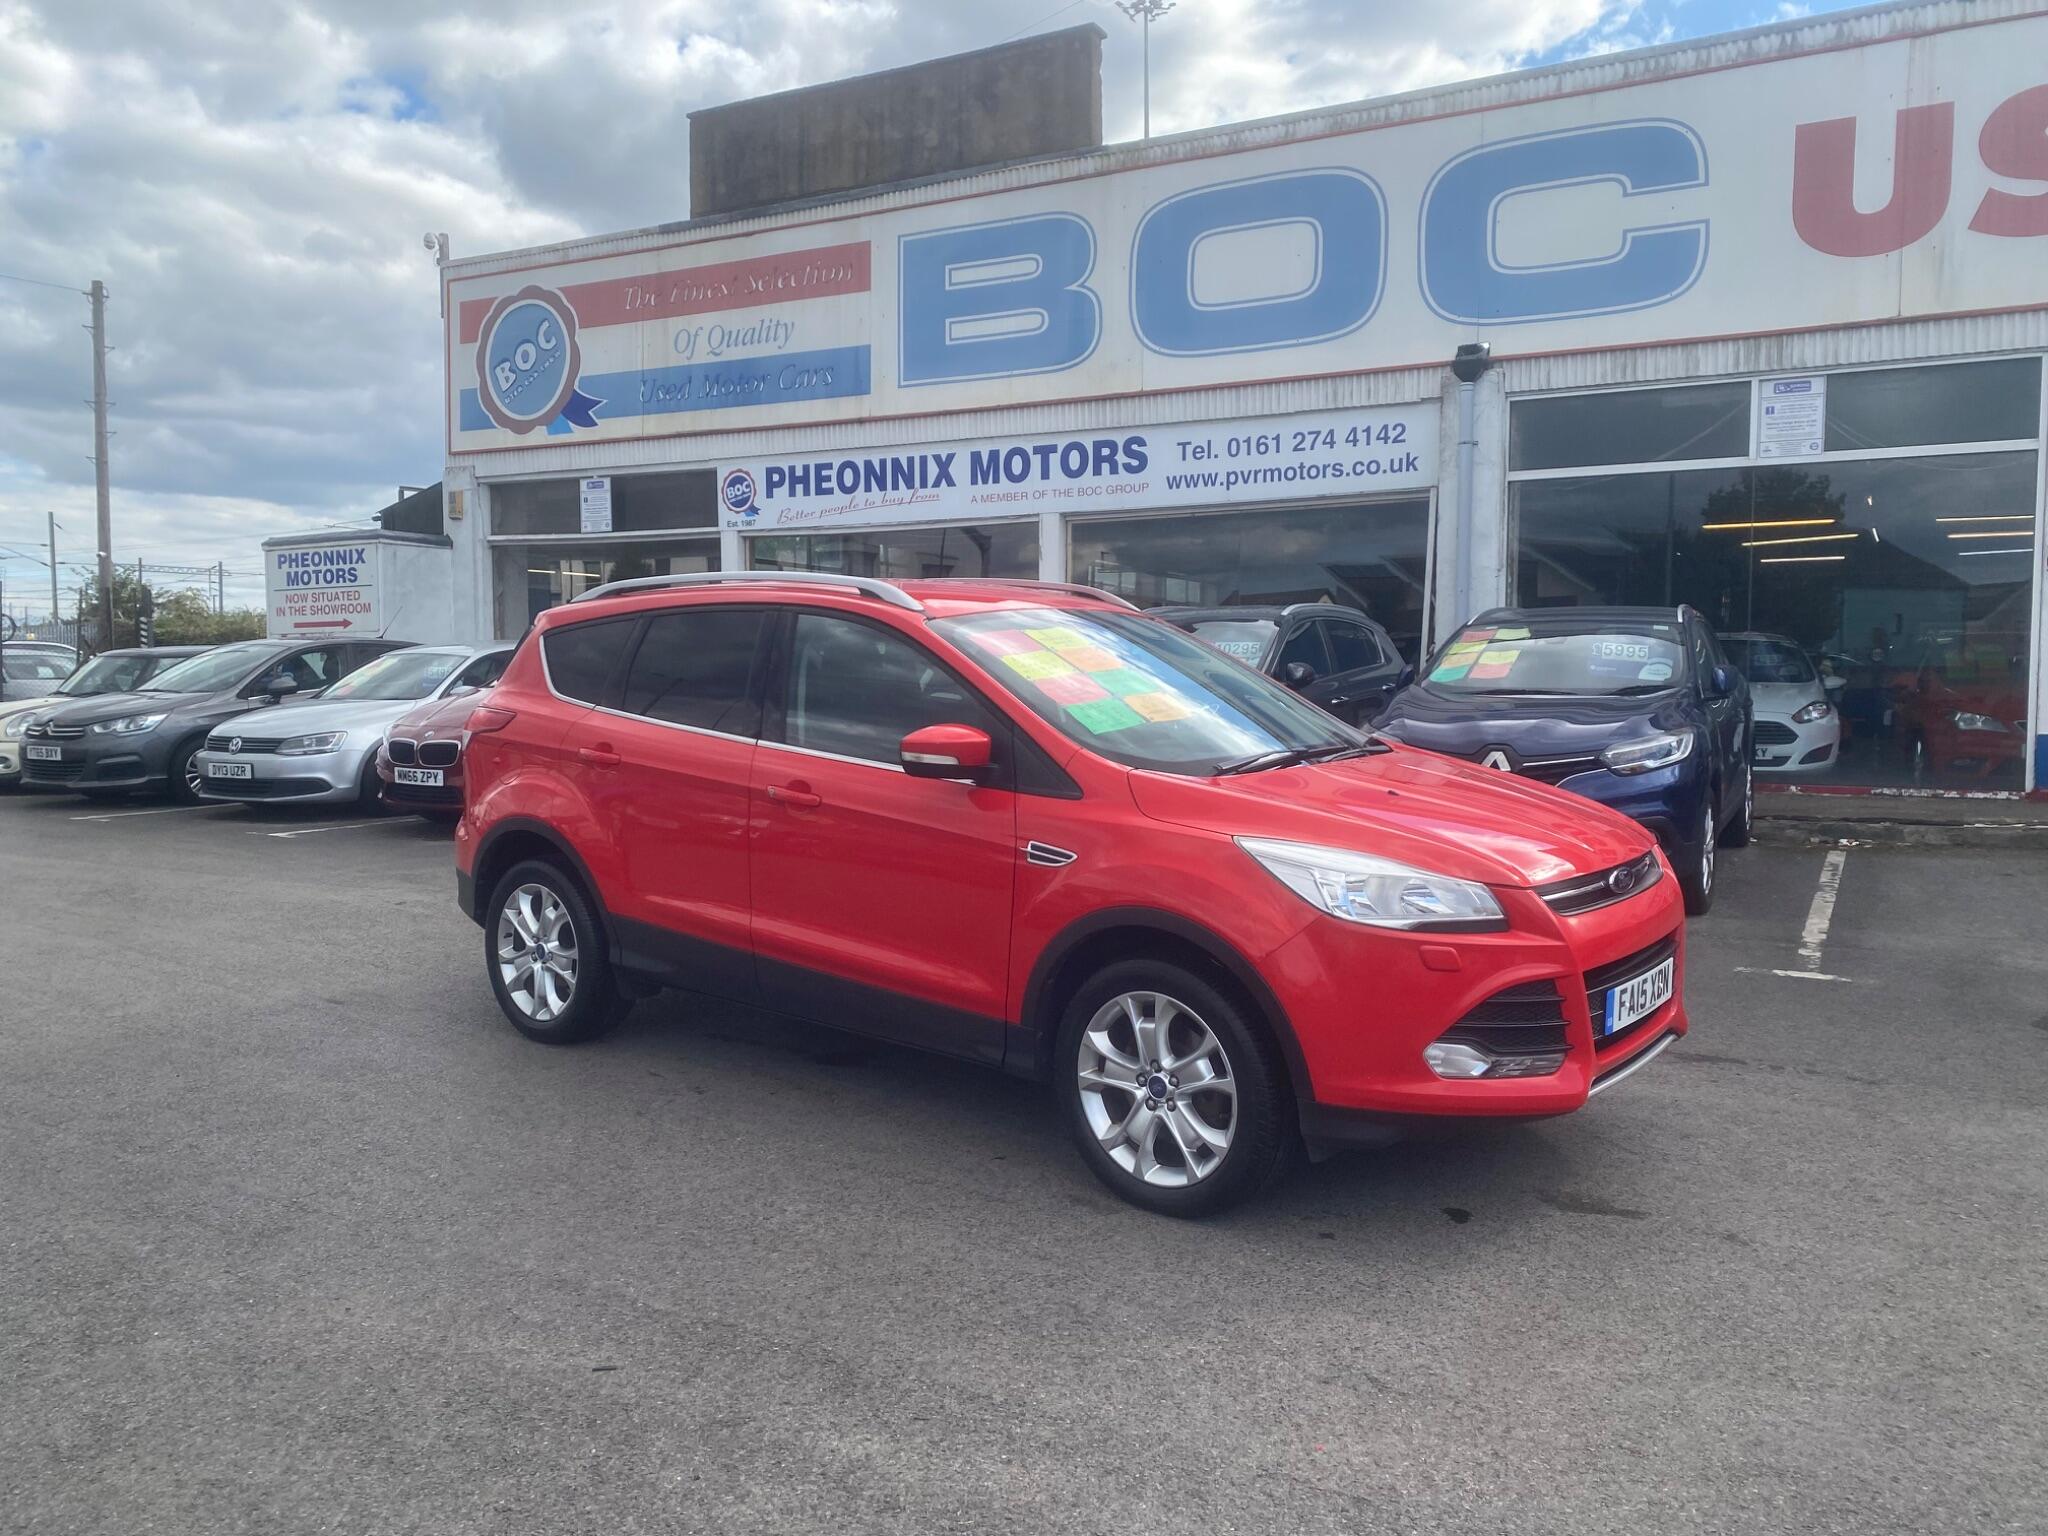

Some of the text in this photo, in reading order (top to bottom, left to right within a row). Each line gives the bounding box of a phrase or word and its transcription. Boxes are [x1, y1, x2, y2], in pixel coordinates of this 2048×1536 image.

[897, 117, 1710, 389] BOC
[624, 260, 854, 310] The Finest Selection
[494, 319, 558, 393] BOC
[674, 318, 795, 361] Of Quality
[639, 363, 835, 402] Used Motor Cars
[1177, 422, 1407, 462] Tel. 0161 274 4142
[765, 436, 1149, 499] PHEONNIX MOTORS
[1166, 452, 1420, 491] www.pvrmotors.co.uk
[727, 480, 751, 499] BOC
[777, 487, 941, 525] Better people to buy from
[970, 482, 1150, 505] A MEMBER OF THE BOC GROUP
[741, 519, 756, 527] 1987
[277, 548, 366, 569] PHEONNIX
[286, 567, 359, 587] MOTORS
[276, 603, 372, 617] IN THE SHOWROOM
[285, 590, 361, 605] NOW SITUATED
[420, 771, 439, 784] ZPY
[1618, 977, 1649, 1022] FA15
